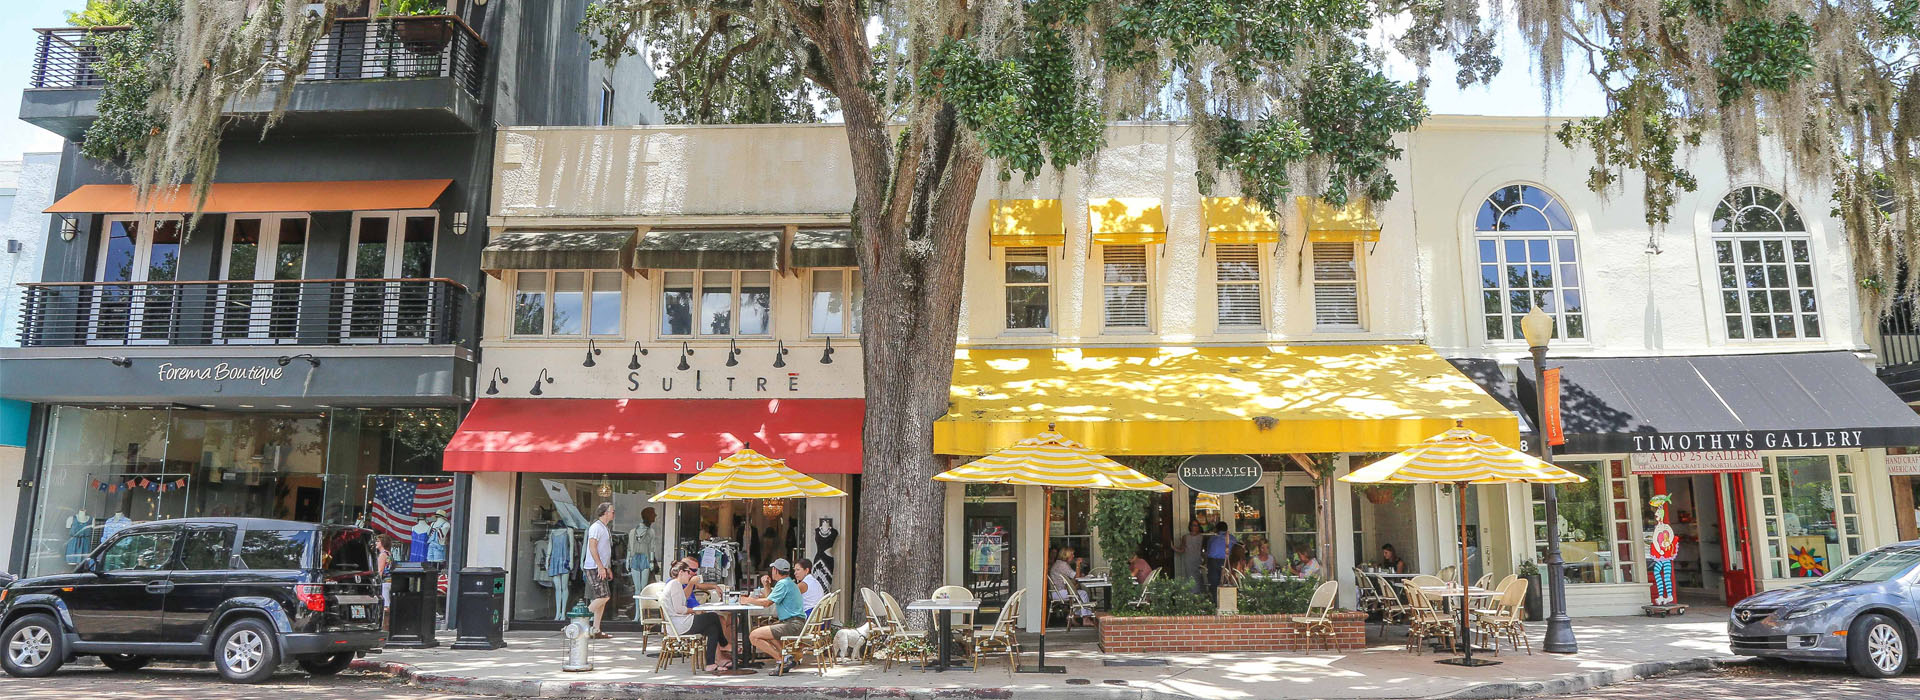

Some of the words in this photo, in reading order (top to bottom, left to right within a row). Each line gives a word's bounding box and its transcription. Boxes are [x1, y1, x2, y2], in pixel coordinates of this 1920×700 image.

[158, 362, 211, 381] Forema
[214, 362, 283, 386] Boutique
[1633, 433, 1754, 451] TIMOTHY'S
[1765, 431, 1862, 448] GALLERY
[1650, 452, 1658, 462] A
[1662, 451, 1686, 461] TOP
[1690, 451, 1702, 461] 25
[1705, 449, 1758, 461] GALLERY
[1183, 466, 1257, 477] BRIARPATCH
